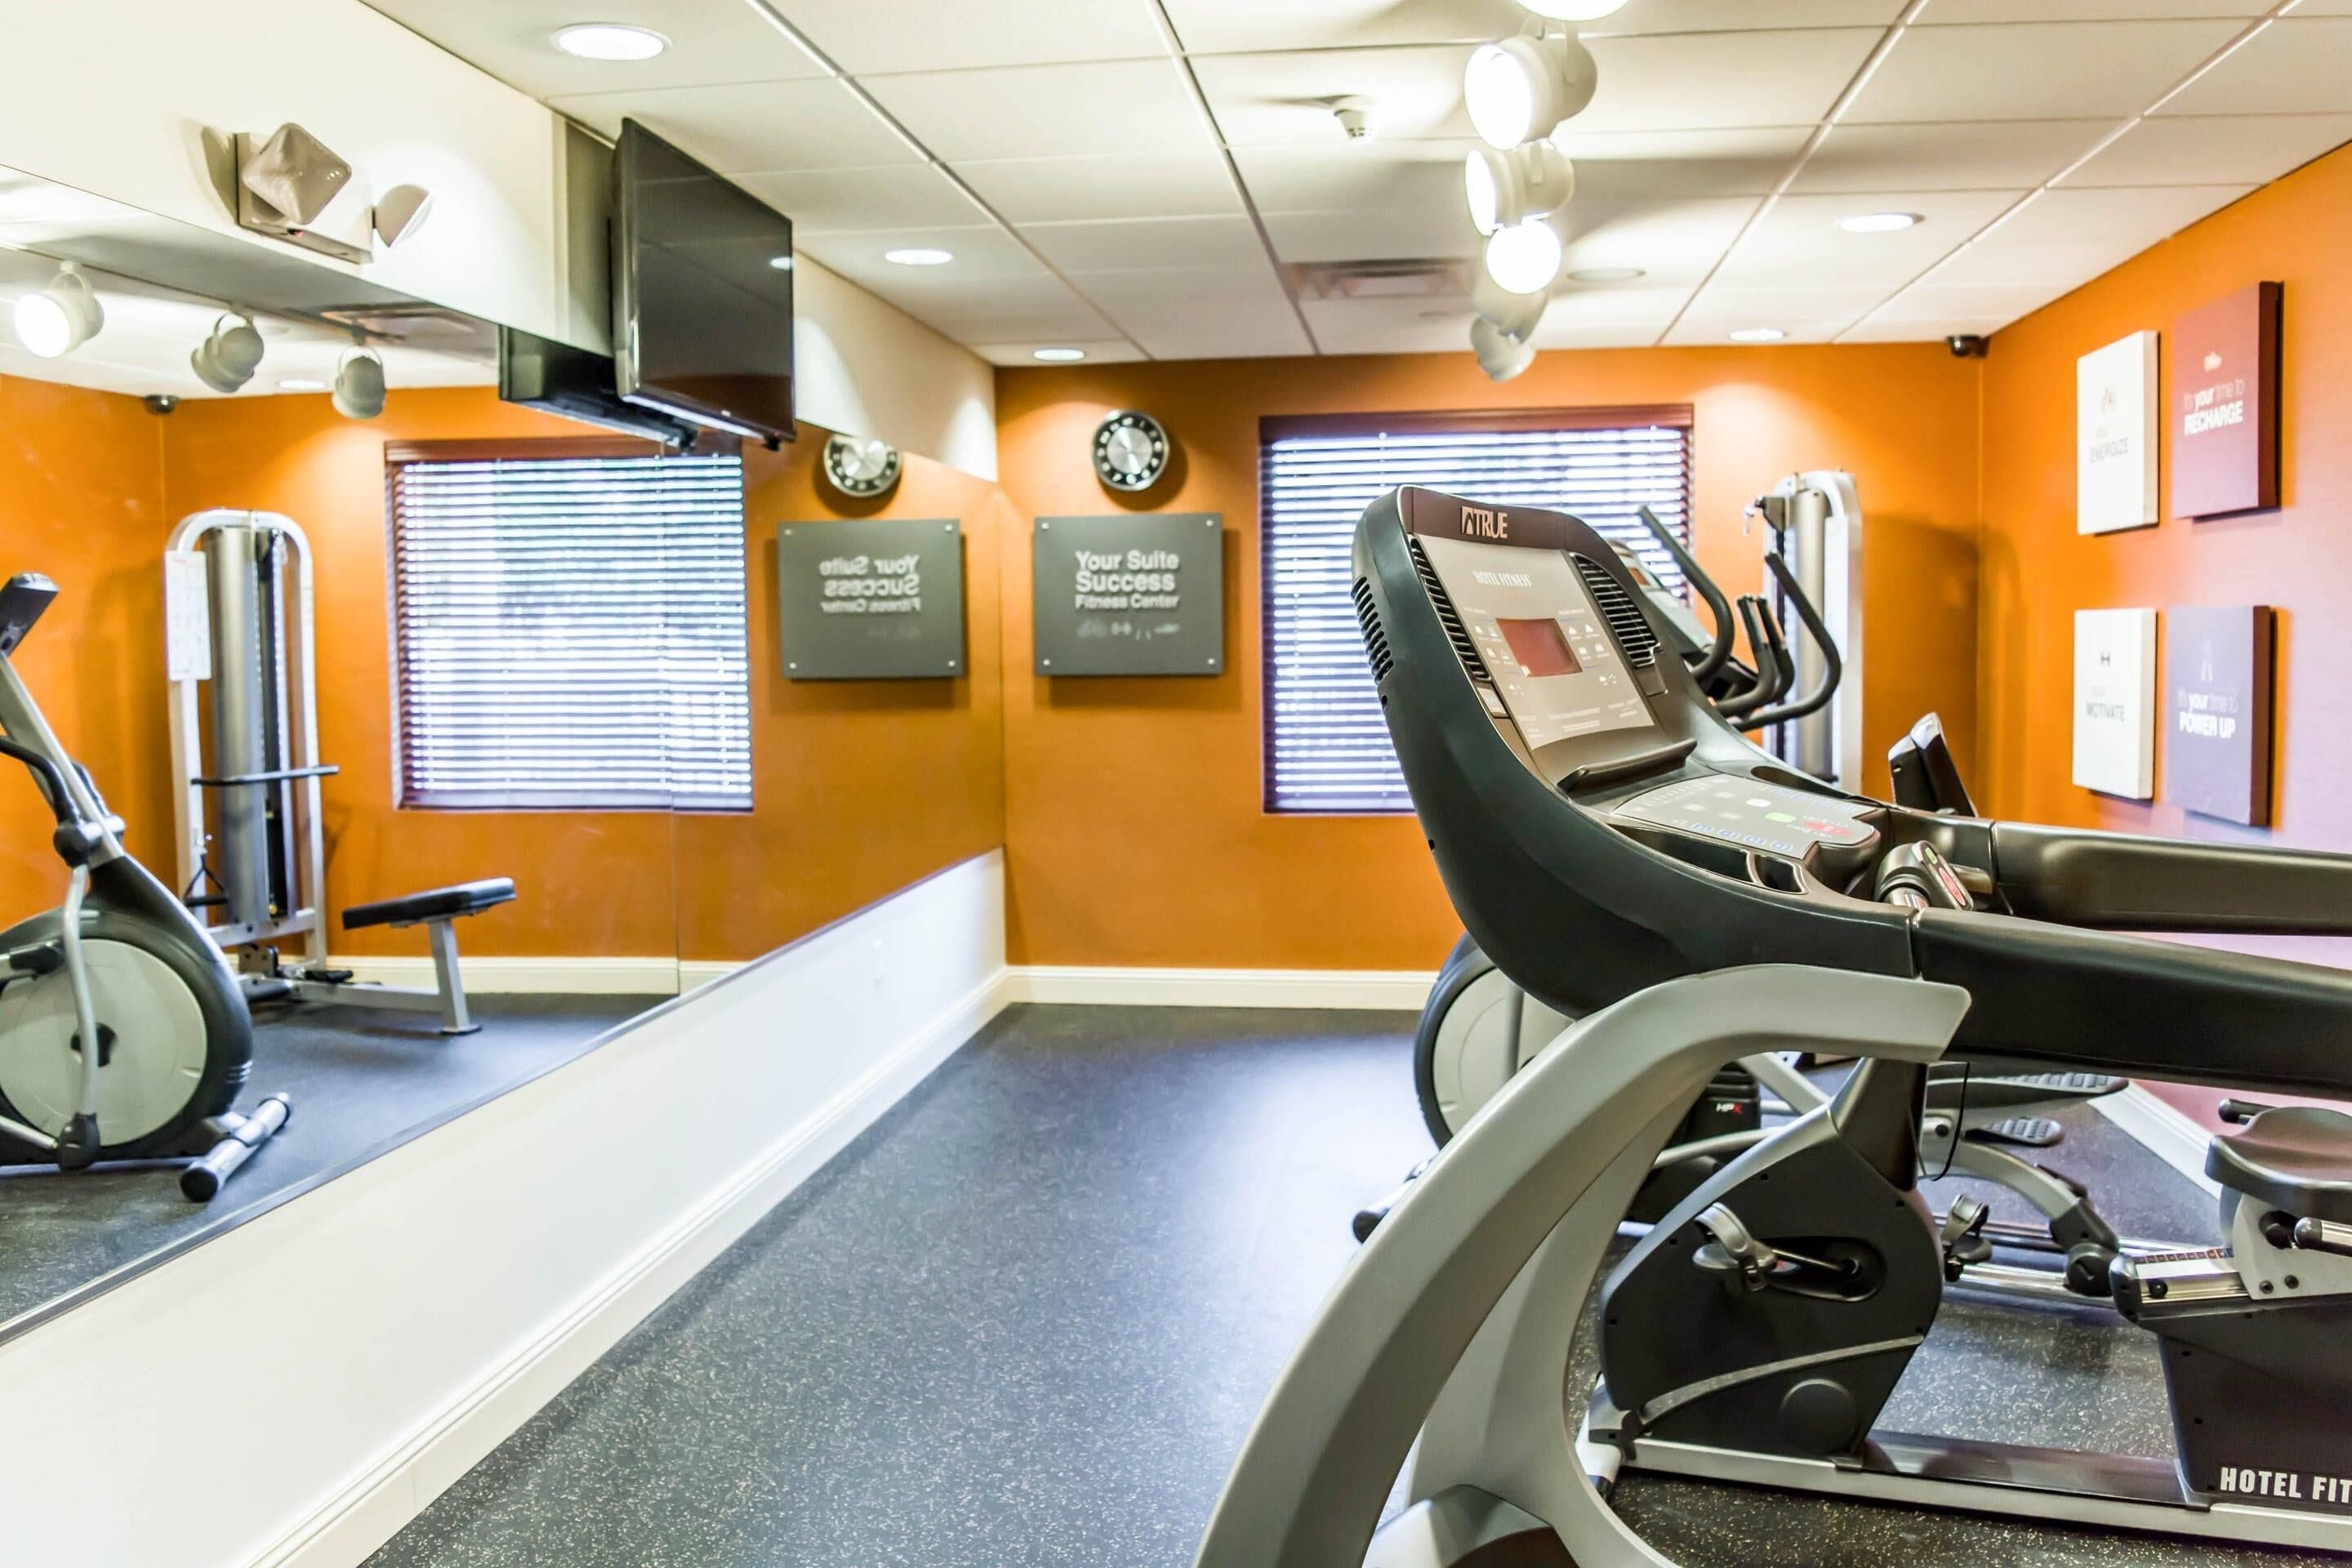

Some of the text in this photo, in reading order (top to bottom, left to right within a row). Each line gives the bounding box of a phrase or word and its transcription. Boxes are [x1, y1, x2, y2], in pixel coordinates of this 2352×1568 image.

[2184, 399, 2243, 435] RECHARGE
[1473, 509, 1508, 539] TRUE
[1075, 550, 1179, 571] Your Suite
[1076, 570, 1176, 593] Success
[1472, 570, 1501, 586] HOTEL
[1075, 593, 1180, 609] Fitness Center
[2179, 710, 2236, 739] POWER UP
[2220, 1467, 2352, 1503] HOTEL FIT
